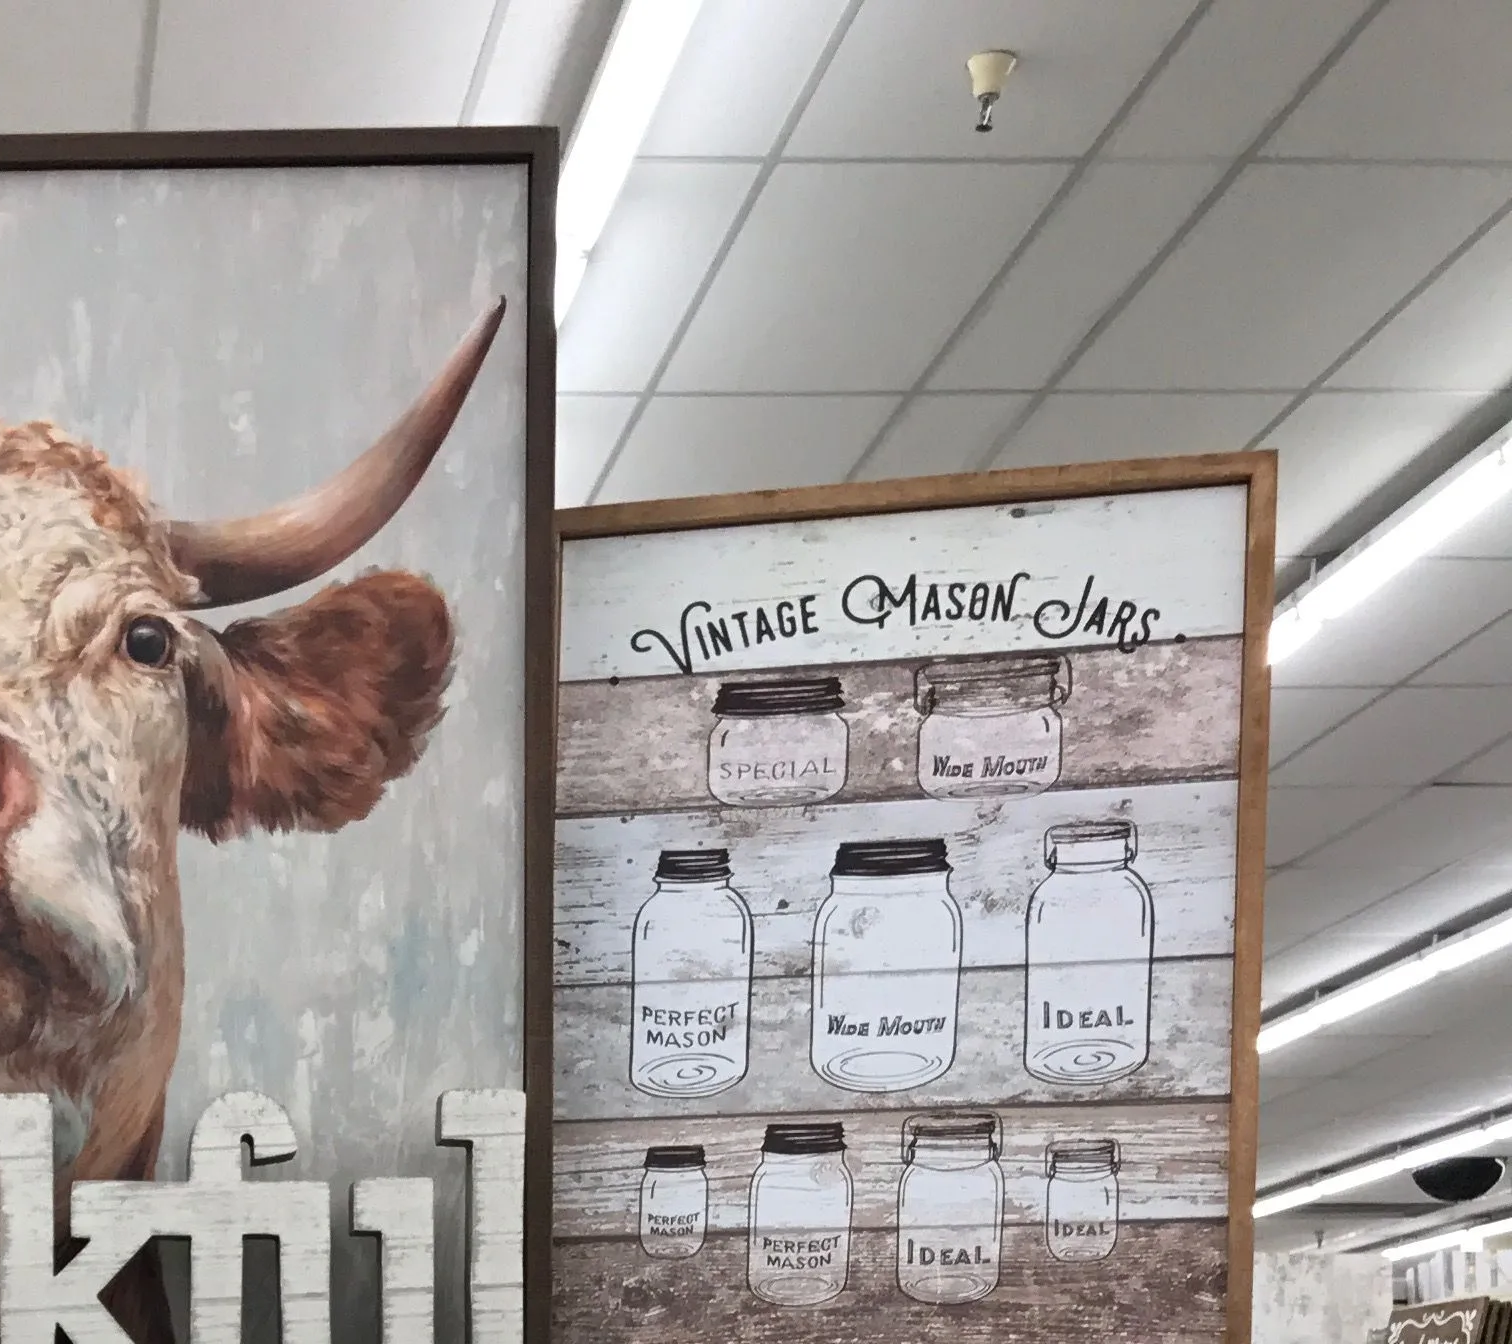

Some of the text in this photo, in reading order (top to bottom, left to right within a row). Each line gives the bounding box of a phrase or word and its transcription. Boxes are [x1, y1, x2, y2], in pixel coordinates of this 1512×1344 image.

[630, 571, 1162, 674] VINTAGE MASON JARS
[719, 757, 837, 783] SPECIAL
[931, 753, 1049, 778] WIDE MOUTH
[641, 1002, 738, 1027] PERFECT
[826, 1014, 947, 1038] WIDE MOUTH
[1042, 1000, 1134, 1031] IDEAL
[645, 1026, 727, 1049] MASON
[647, 1212, 701, 1227] PERFECT
[650, 1225, 694, 1238] MASON
[1053, 1218, 1110, 1237] IDEAL
[762, 1235, 842, 1255] PERFECT
[907, 1238, 991, 1265] IDEAL
[766, 1252, 832, 1270] MASON
